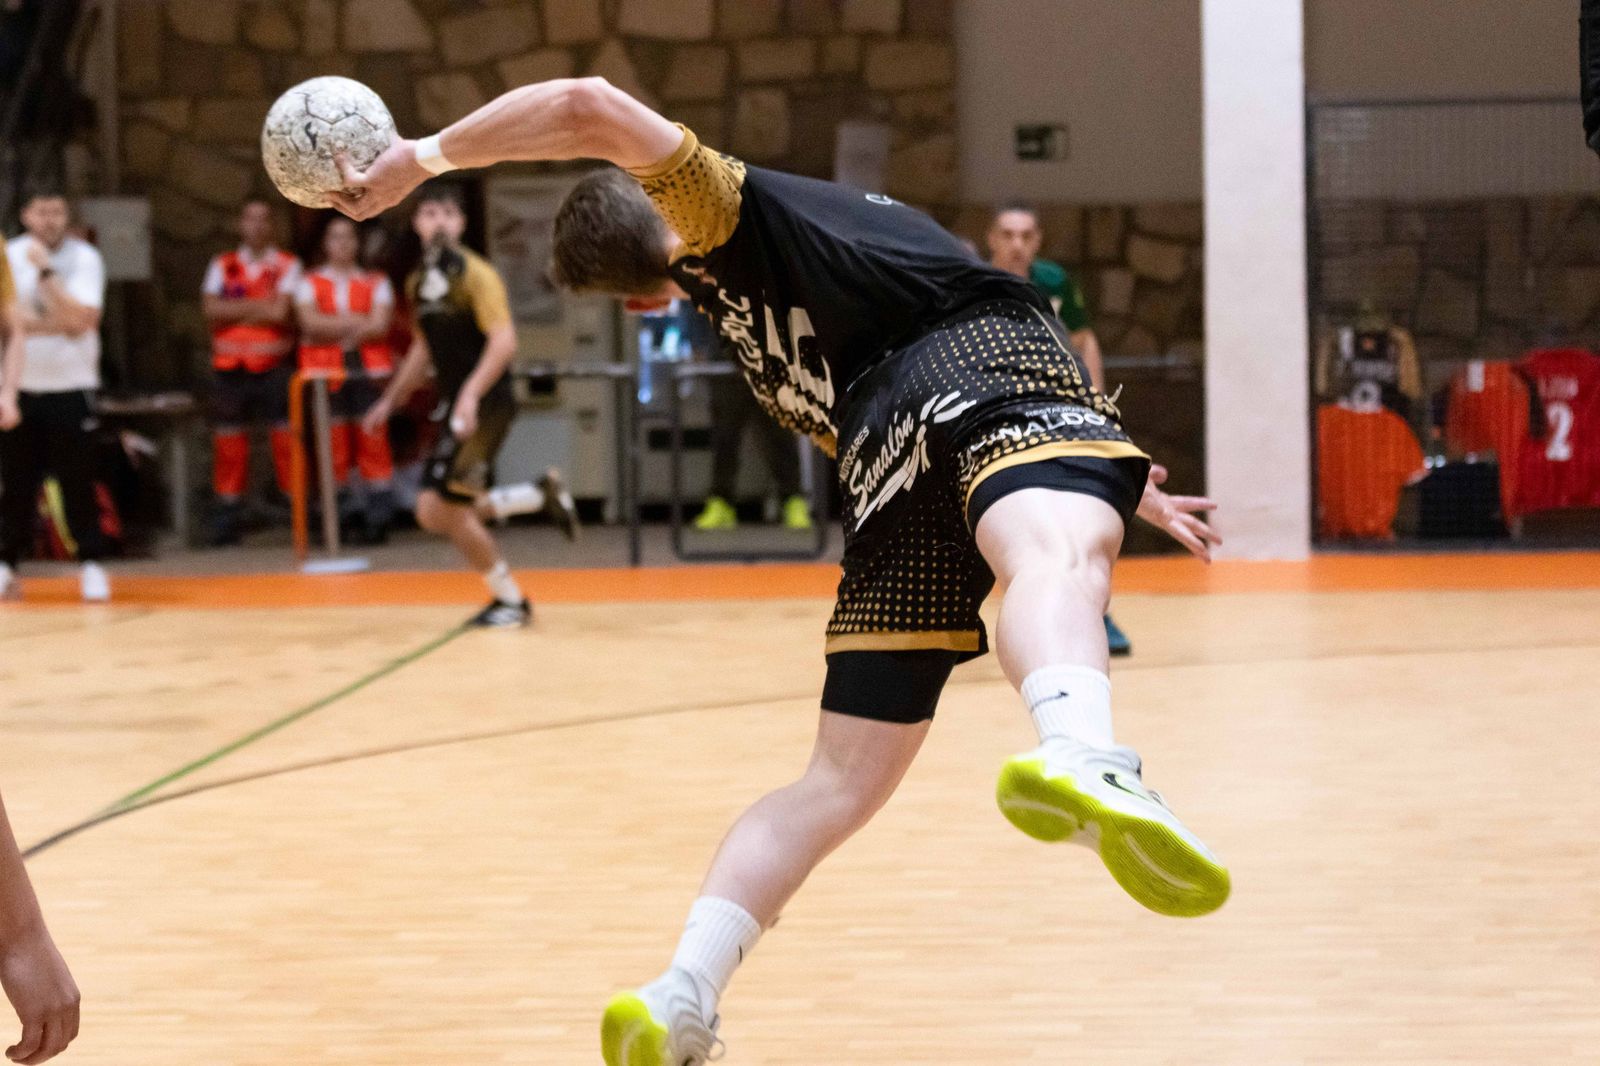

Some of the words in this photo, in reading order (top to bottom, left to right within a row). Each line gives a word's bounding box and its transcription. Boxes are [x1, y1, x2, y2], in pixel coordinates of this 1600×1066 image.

[839, 426, 870, 482] AUTOCARES
[1545, 402, 1574, 461] 2
[849, 411, 914, 519] Sanalón
